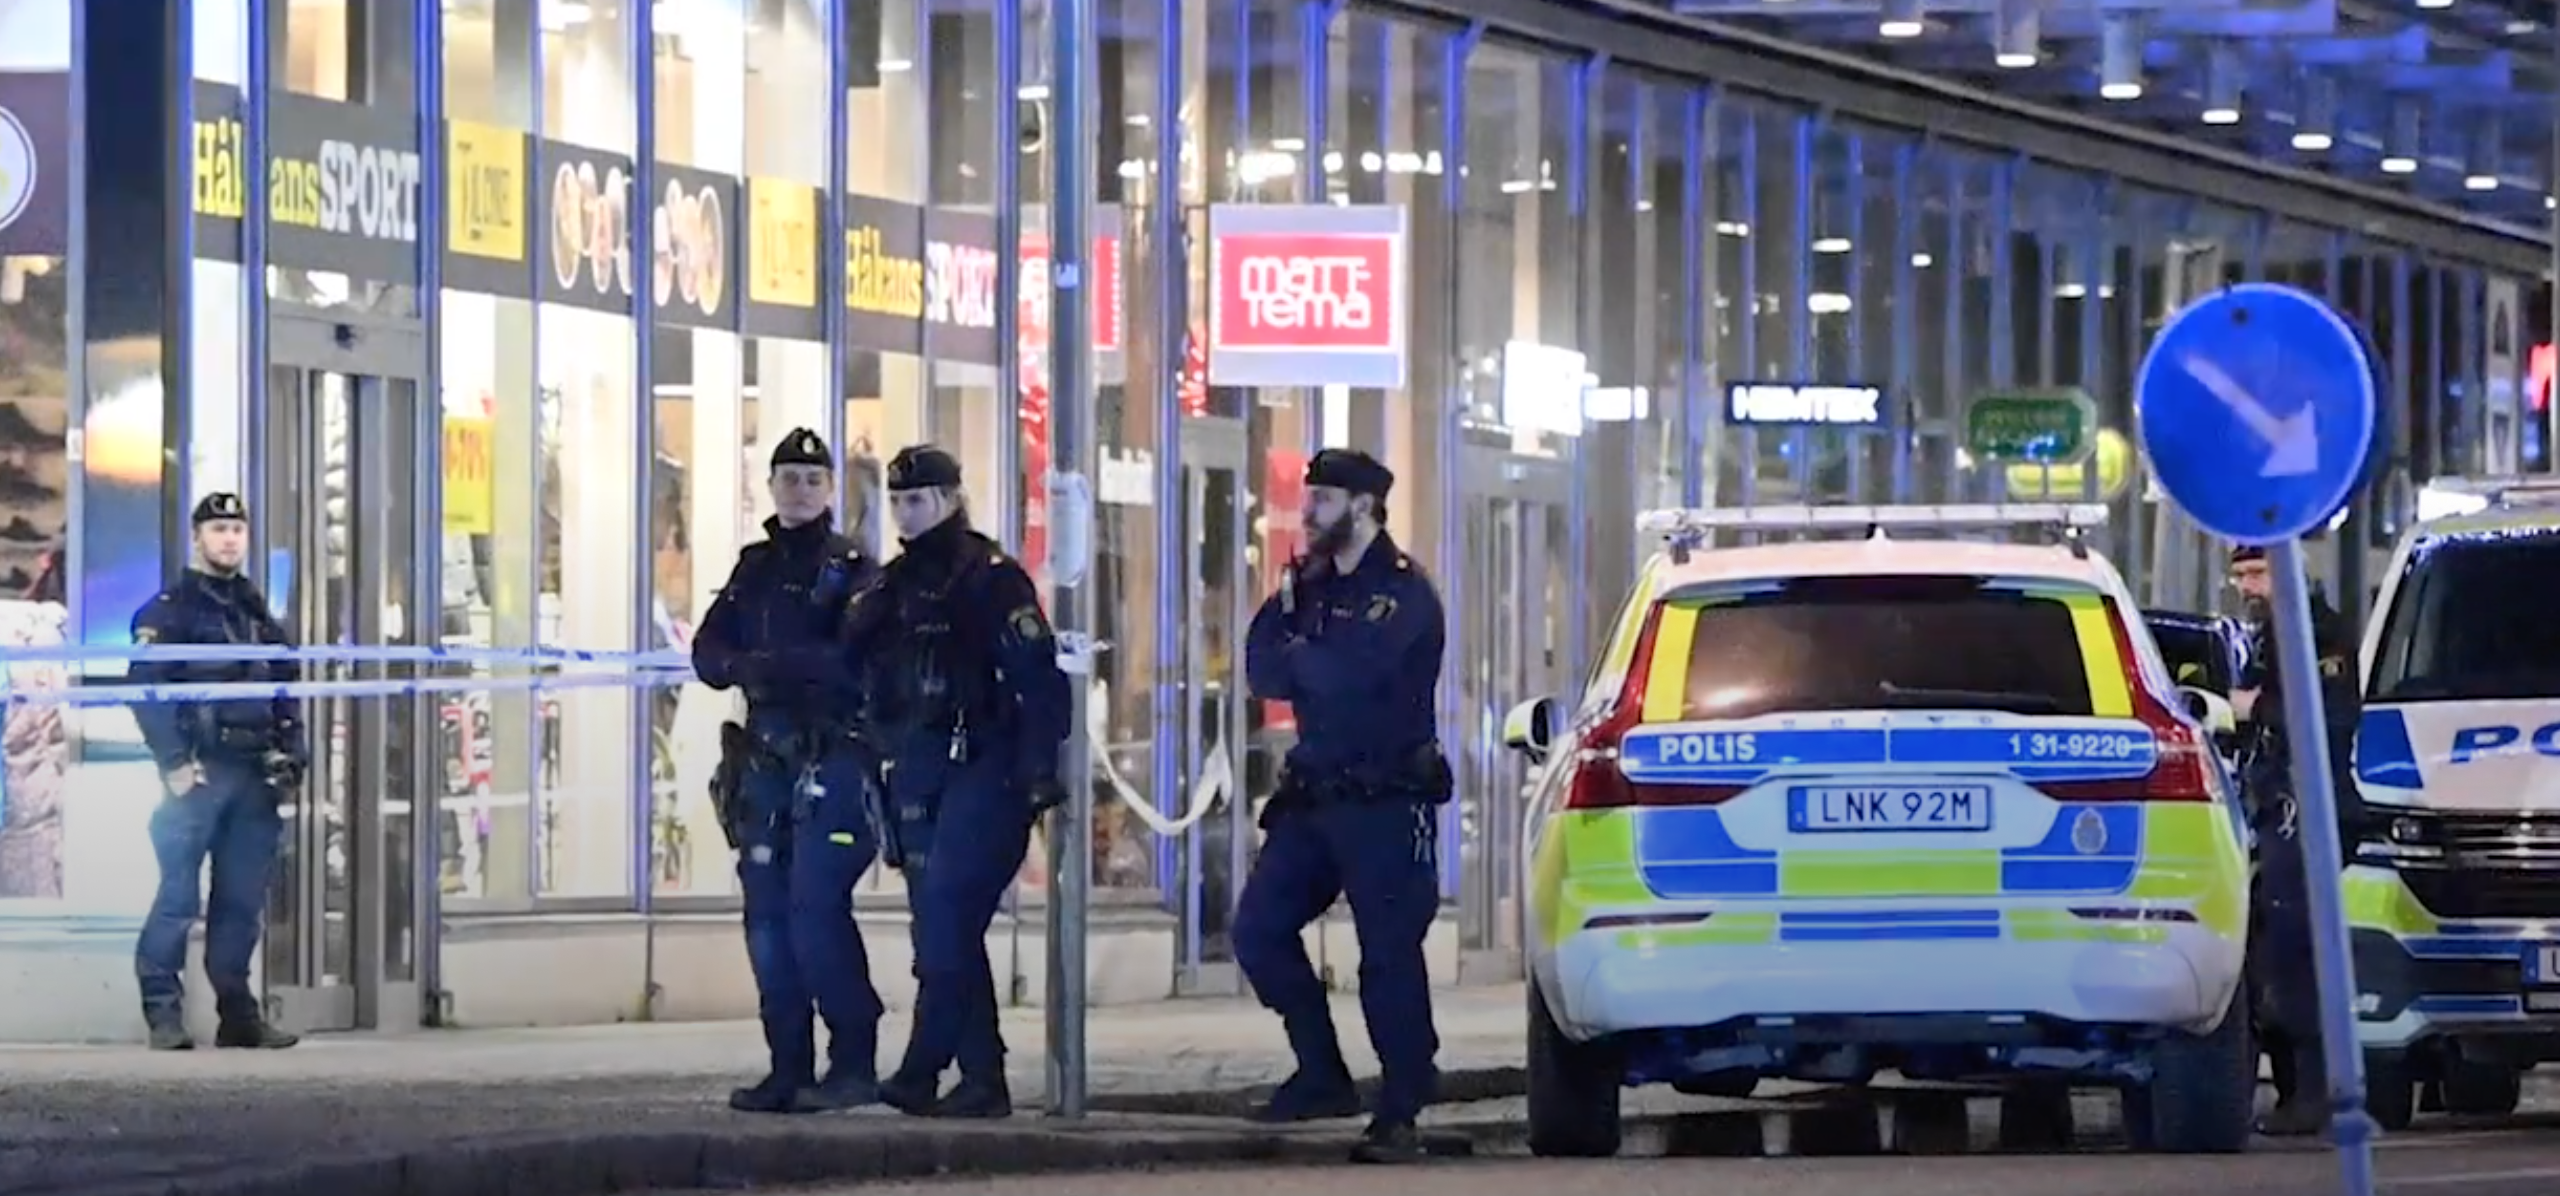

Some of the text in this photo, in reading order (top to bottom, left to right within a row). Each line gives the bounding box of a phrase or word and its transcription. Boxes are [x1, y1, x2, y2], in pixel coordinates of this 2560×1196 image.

[1658, 733, 1757, 764] POLIS
[2009, 733, 2021, 756] 1
[1822, 791, 1972, 823] LNK 92M
